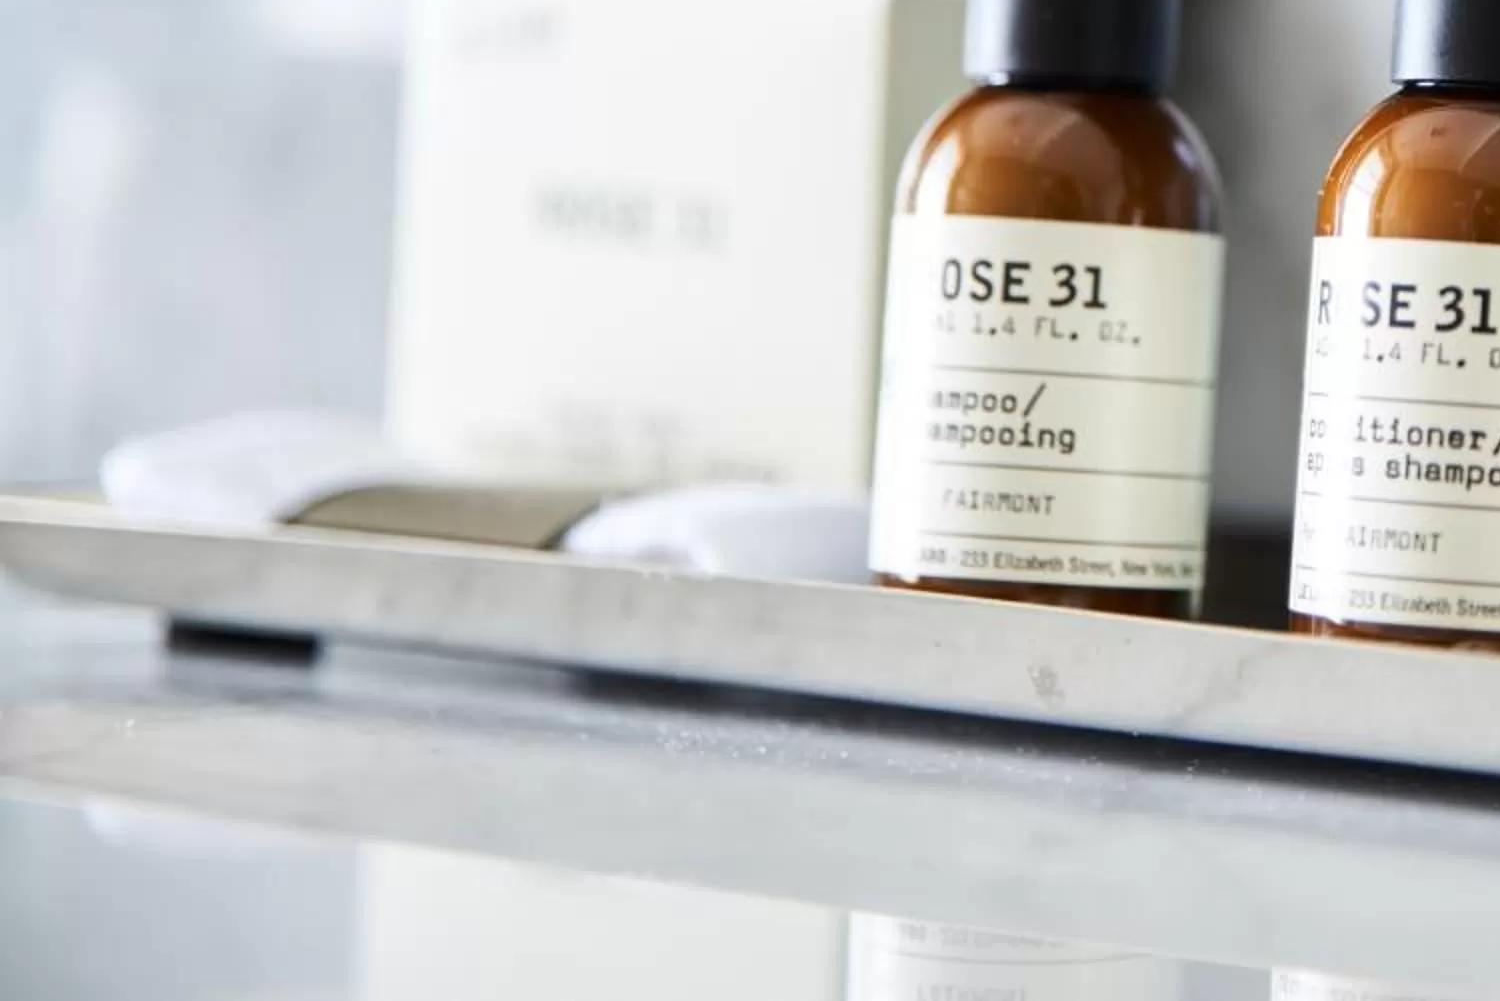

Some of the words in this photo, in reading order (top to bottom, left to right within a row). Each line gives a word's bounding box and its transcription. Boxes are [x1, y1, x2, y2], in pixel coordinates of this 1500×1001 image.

[941, 259, 1031, 305] OSE
[1048, 263, 1107, 310] 31
[1317, 279, 1417, 330] RSE
[1435, 285, 1498, 335] 31
[973, 313, 1016, 337] 1.4
[1034, 315, 1080, 342] FL.
[1098, 319, 1142, 347] OZ.
[1362, 339, 1402, 365] 1.4
[1420, 342, 1467, 370] FL.
[932, 383, 1047, 418] ampoo/
[928, 422, 1077, 455] ampooing
[943, 489, 1056, 515] FAIRMONT
[1345, 525, 1443, 555] AIRMONT
